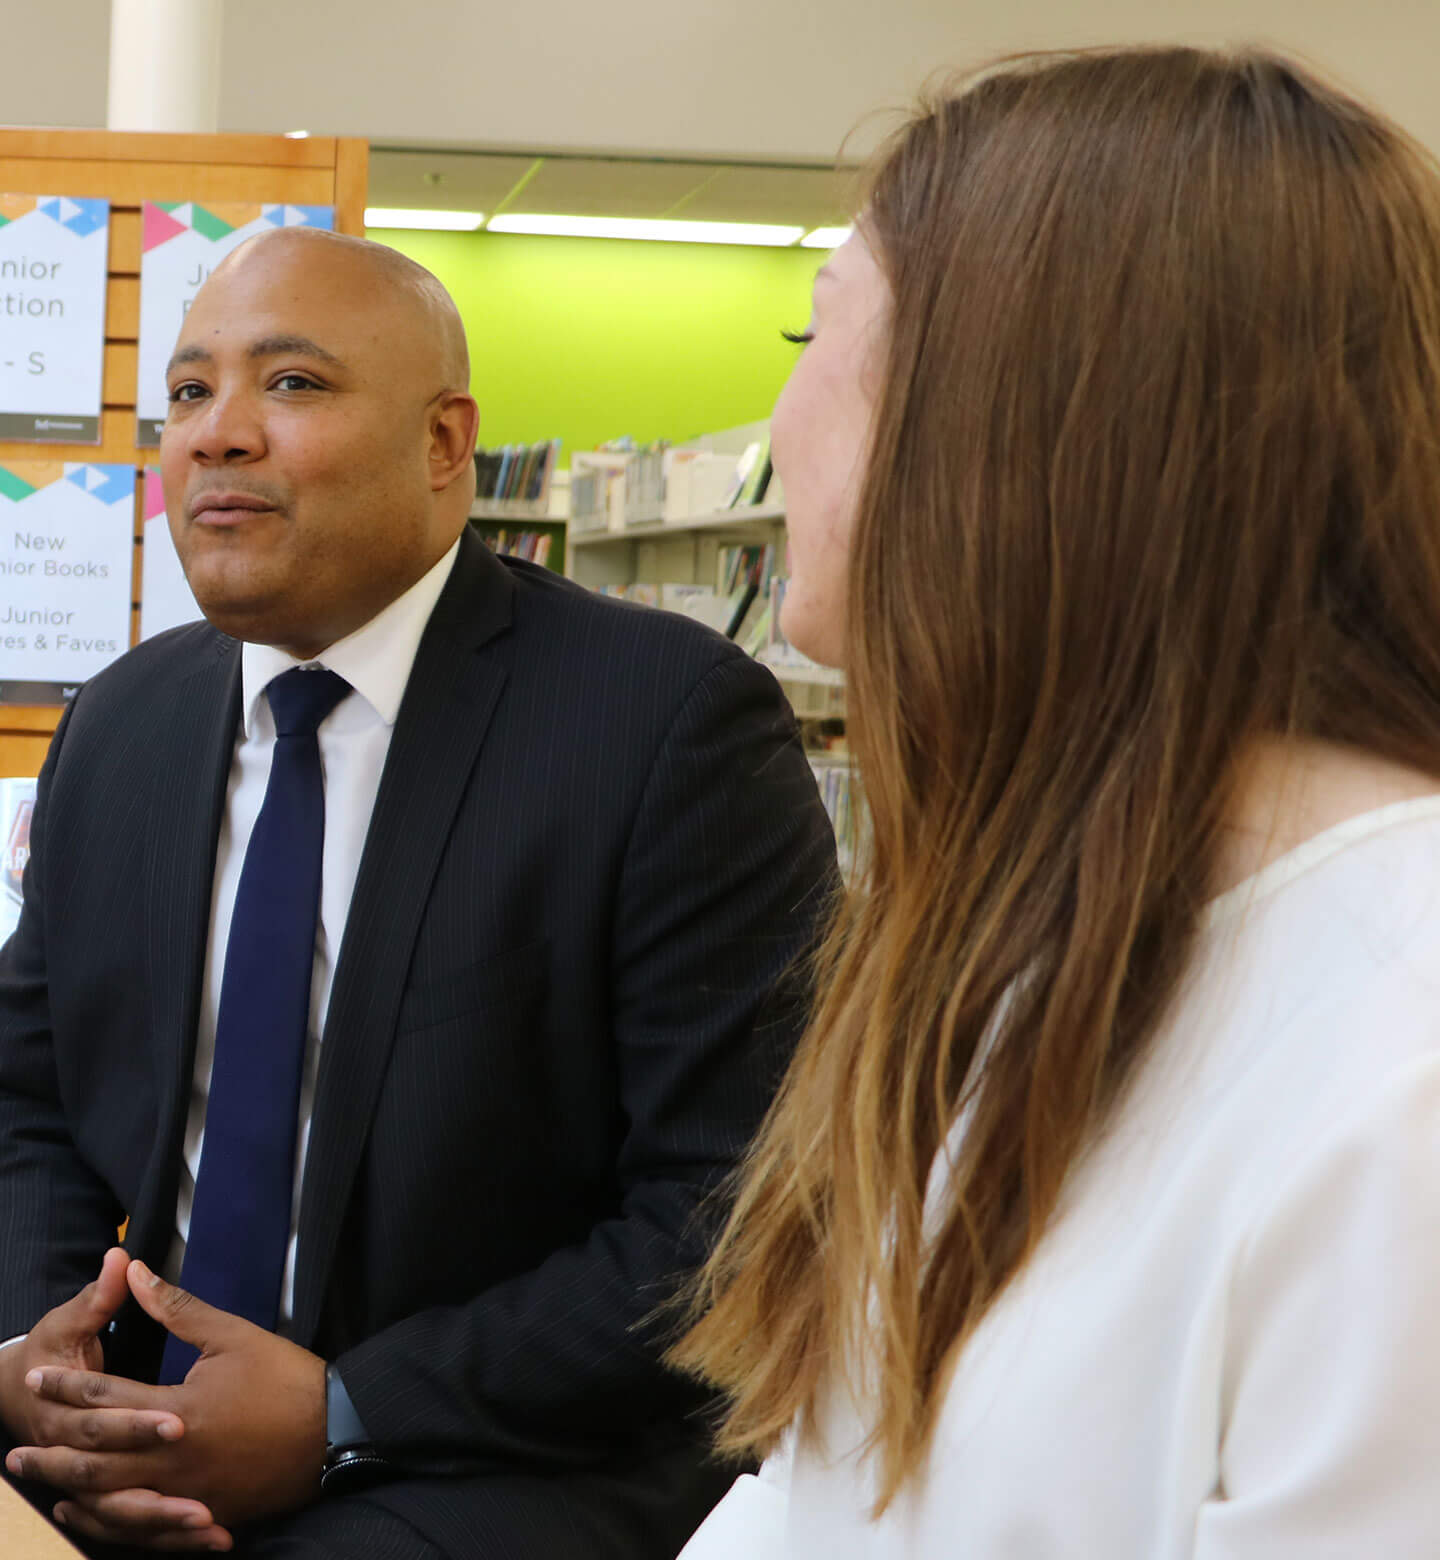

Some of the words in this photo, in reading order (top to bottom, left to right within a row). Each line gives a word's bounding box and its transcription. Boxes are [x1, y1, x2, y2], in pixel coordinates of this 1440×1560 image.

[27, 350, 46, 376] S
[14, 531, 66, 551] New
[43, 559, 110, 578] Books
[0, 606, 76, 626] Junior
[33, 632, 49, 651] &
[56, 634, 118, 653] Faves
